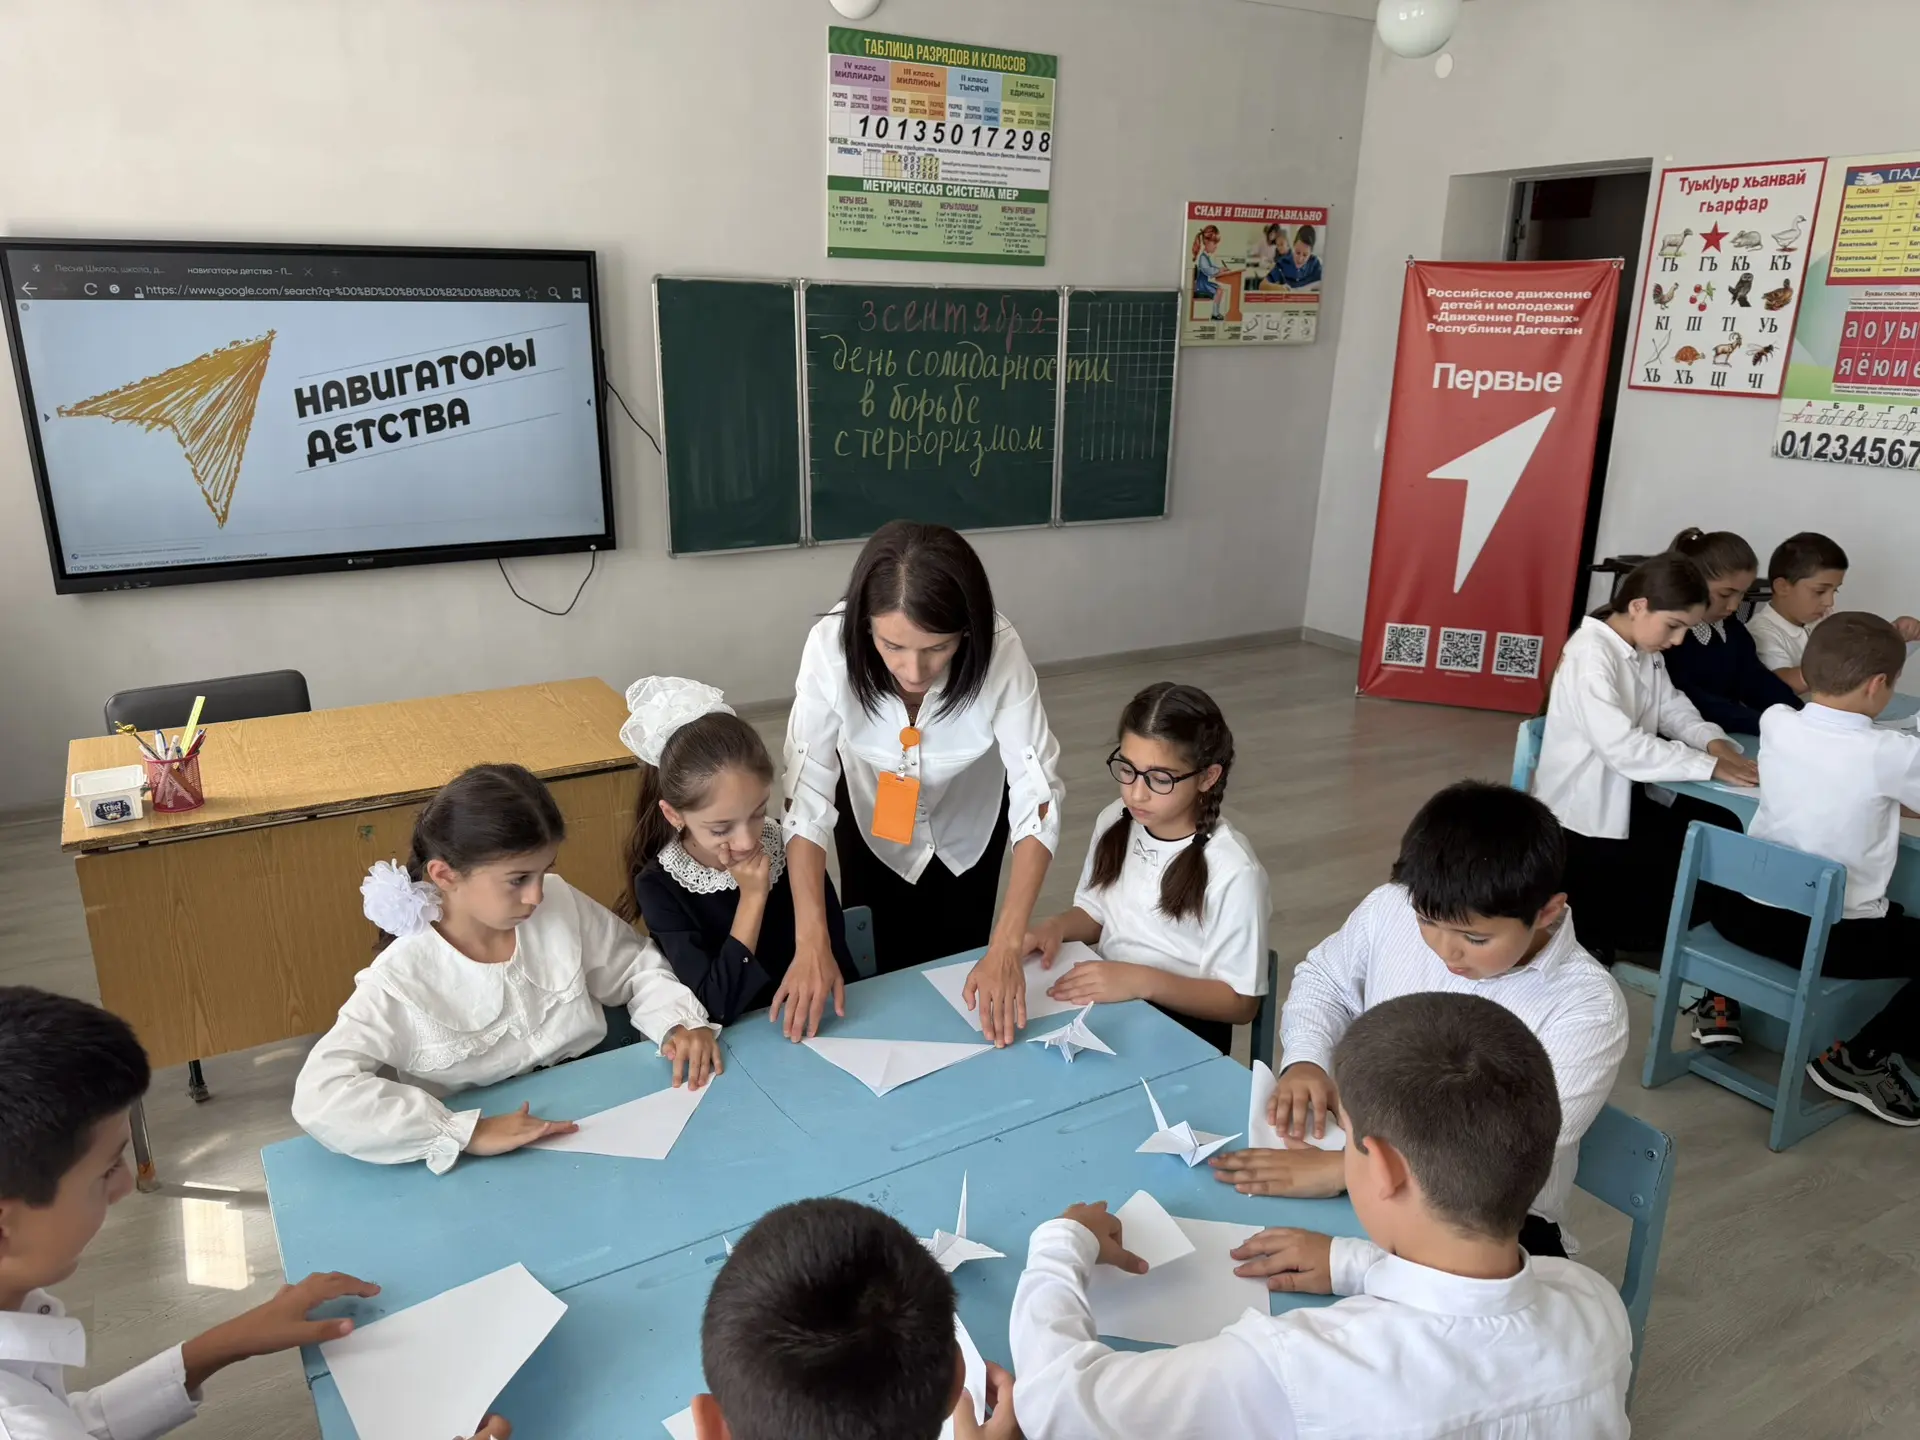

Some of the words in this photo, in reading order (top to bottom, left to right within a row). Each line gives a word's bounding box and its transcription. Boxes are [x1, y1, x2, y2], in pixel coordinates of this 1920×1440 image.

[864, 38, 914, 60] ТАБЛИЦА
[916, 46, 969, 66] РАЗРЯДОВ
[971, 53, 979, 67] И
[981, 54, 1027, 73] КЛАССОВ
[835, 70, 885, 82] МИЛЛИАРДЫ
[896, 77, 940, 87] МИЛЛИОНЫ
[912, 70, 934, 78] класс
[959, 84, 989, 93] ТЫСЯЧИ
[1010, 89, 1045, 99] ЕДИНИЦЫ
[1742, 169, 1807, 188] хьанвай
[863, 179, 943, 196] МЕТРИЧЕСКАЯ
[945, 185, 995, 199] СИСТЕМА
[997, 188, 1019, 200] МЕР
[1194, 205, 1222, 217] СИДИ
[1224, 206, 1232, 217] И
[1234, 207, 1265, 219] ПИШИ
[1266, 209, 1323, 221] ПРАВИЛЬНО
[1698, 195, 1769, 215] гьарфар
[187, 267, 239, 276] навигаторы
[239, 268, 273, 276] детства
[1426, 288, 1513, 299] Российское
[1516, 290, 1592, 300] движение
[1440, 300, 1482, 311] детей
[1485, 302, 1494, 310] и
[1497, 302, 1574, 312] молодежи
[1426, 323, 1512, 335] Республики
[1513, 325, 1583, 336] Дагестан
[820, 334, 897, 376] день
[294, 338, 537, 418] НАВИГАТОРЫ
[1432, 362, 1563, 399] Первые
[859, 379, 875, 417] в
[889, 384, 980, 435] борьбе
[306, 397, 471, 468] ДЕТСТВА
[834, 430, 852, 457] с
[855, 425, 1044, 477] терроризмом
